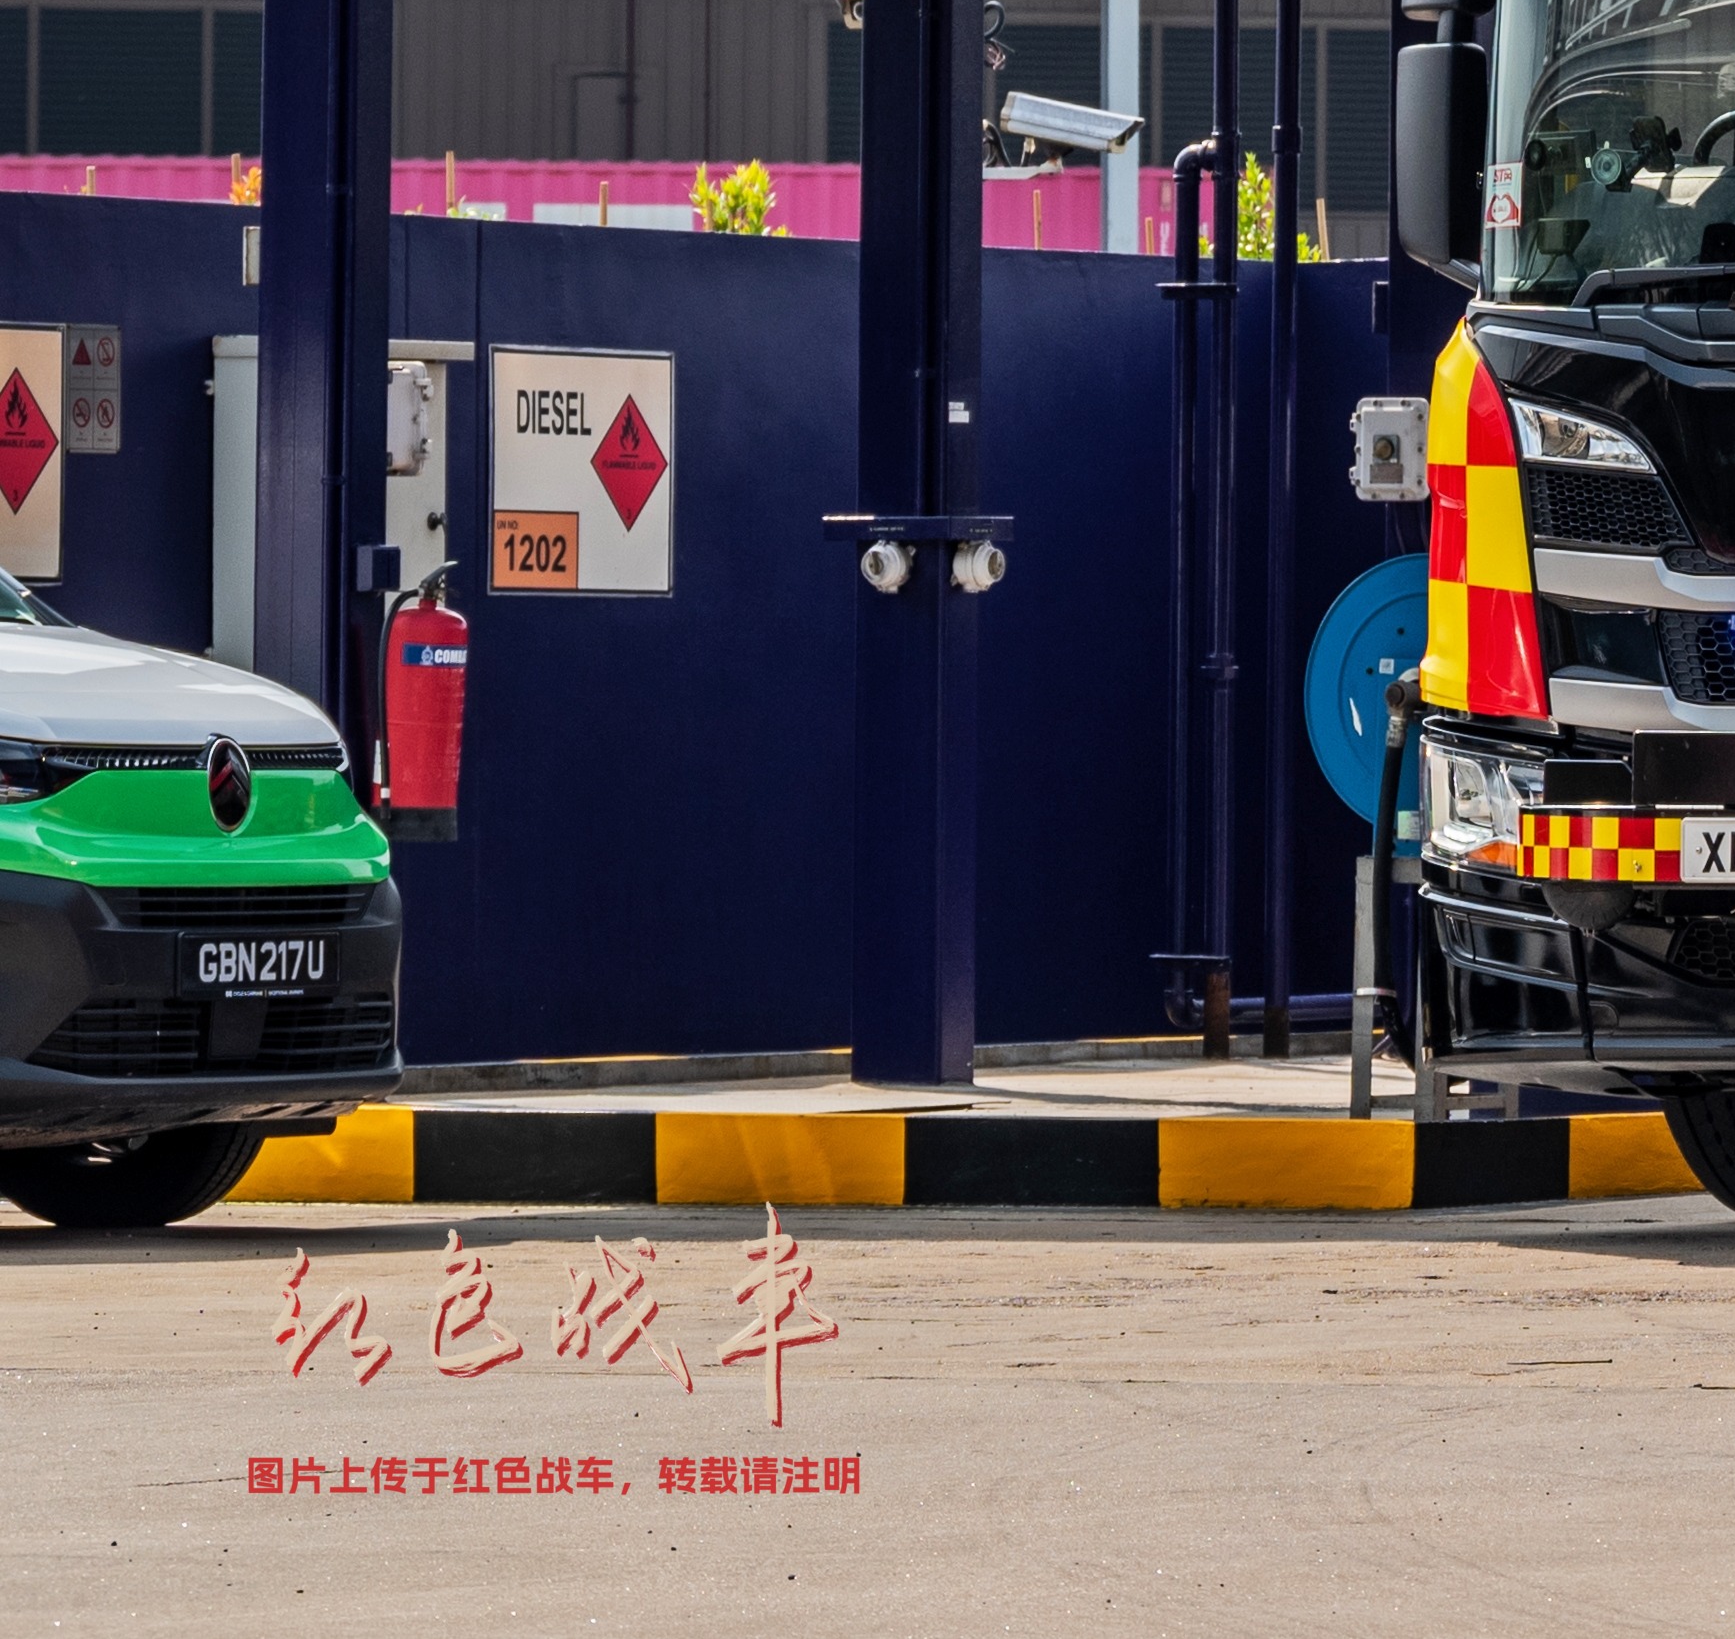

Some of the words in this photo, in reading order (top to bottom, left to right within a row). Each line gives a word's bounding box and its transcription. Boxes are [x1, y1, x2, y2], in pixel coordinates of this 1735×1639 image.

[517, 390, 592, 436] DIESEL
[497, 520, 507, 530] UN
[504, 534, 567, 573] 1202
